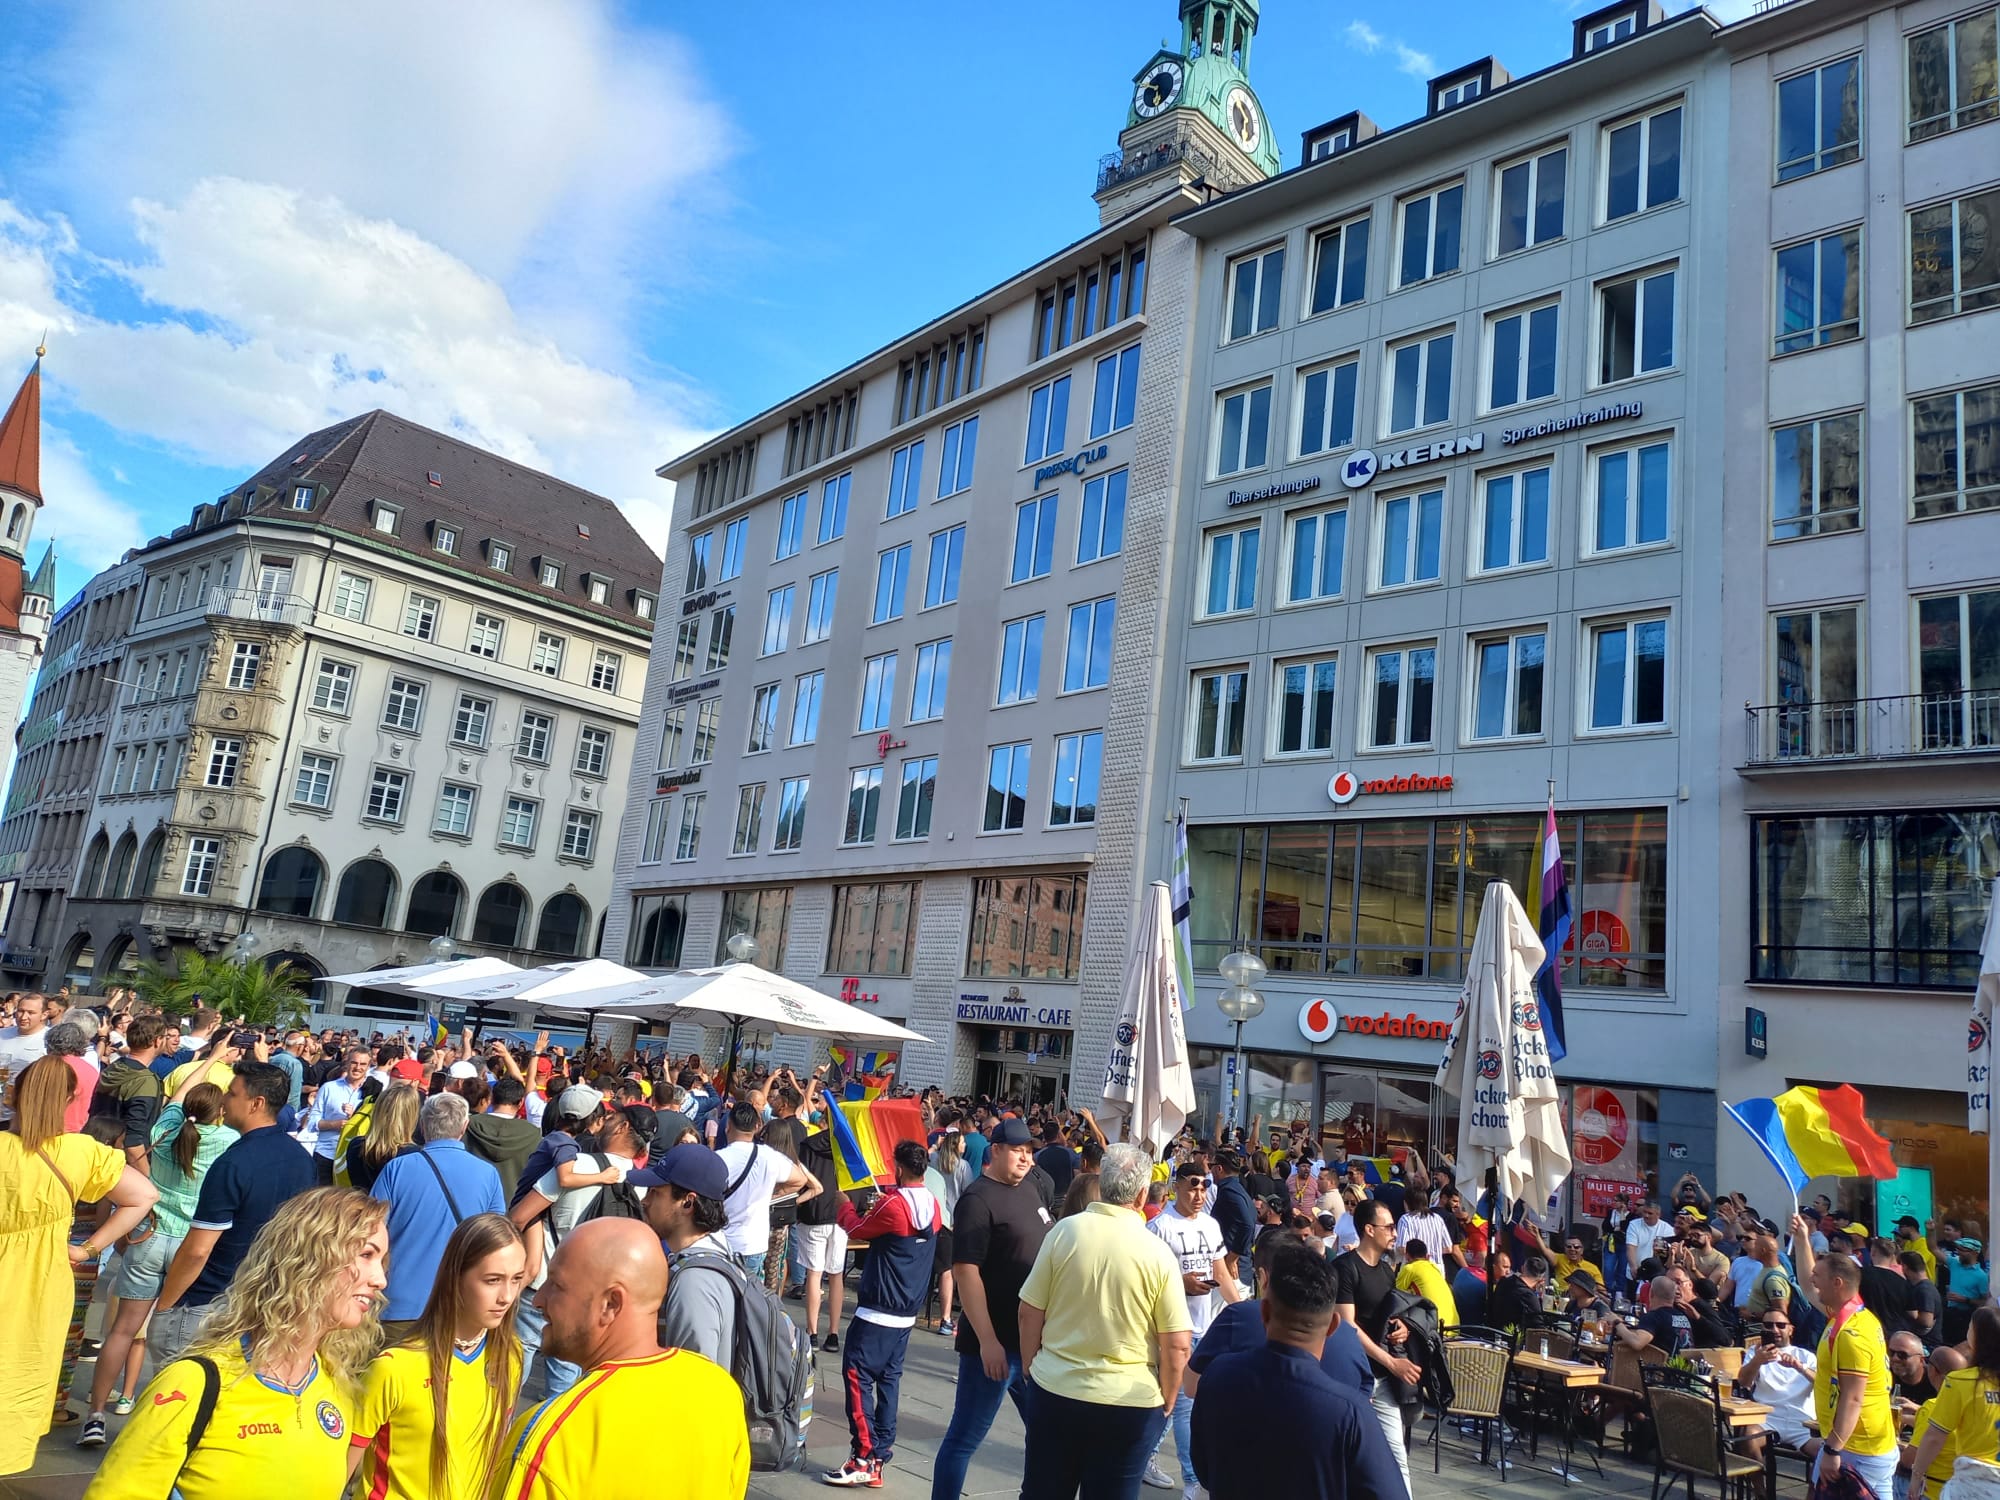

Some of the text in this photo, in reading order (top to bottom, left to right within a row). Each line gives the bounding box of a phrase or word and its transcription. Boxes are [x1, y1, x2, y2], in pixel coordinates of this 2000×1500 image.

[1501, 401, 1643, 445] Sprachentraining
[1381, 432, 1485, 472] KERN
[1227, 476, 1320, 507] Übersetzungen
[1362, 772, 1454, 794] vodafone
[1586, 939, 1606, 948] GIGA
[957, 1003, 1030, 1023] RESTAURANT
[1038, 1008, 1072, 1026] CAFE
[1587, 1181, 1641, 1195] MUIE PSD
